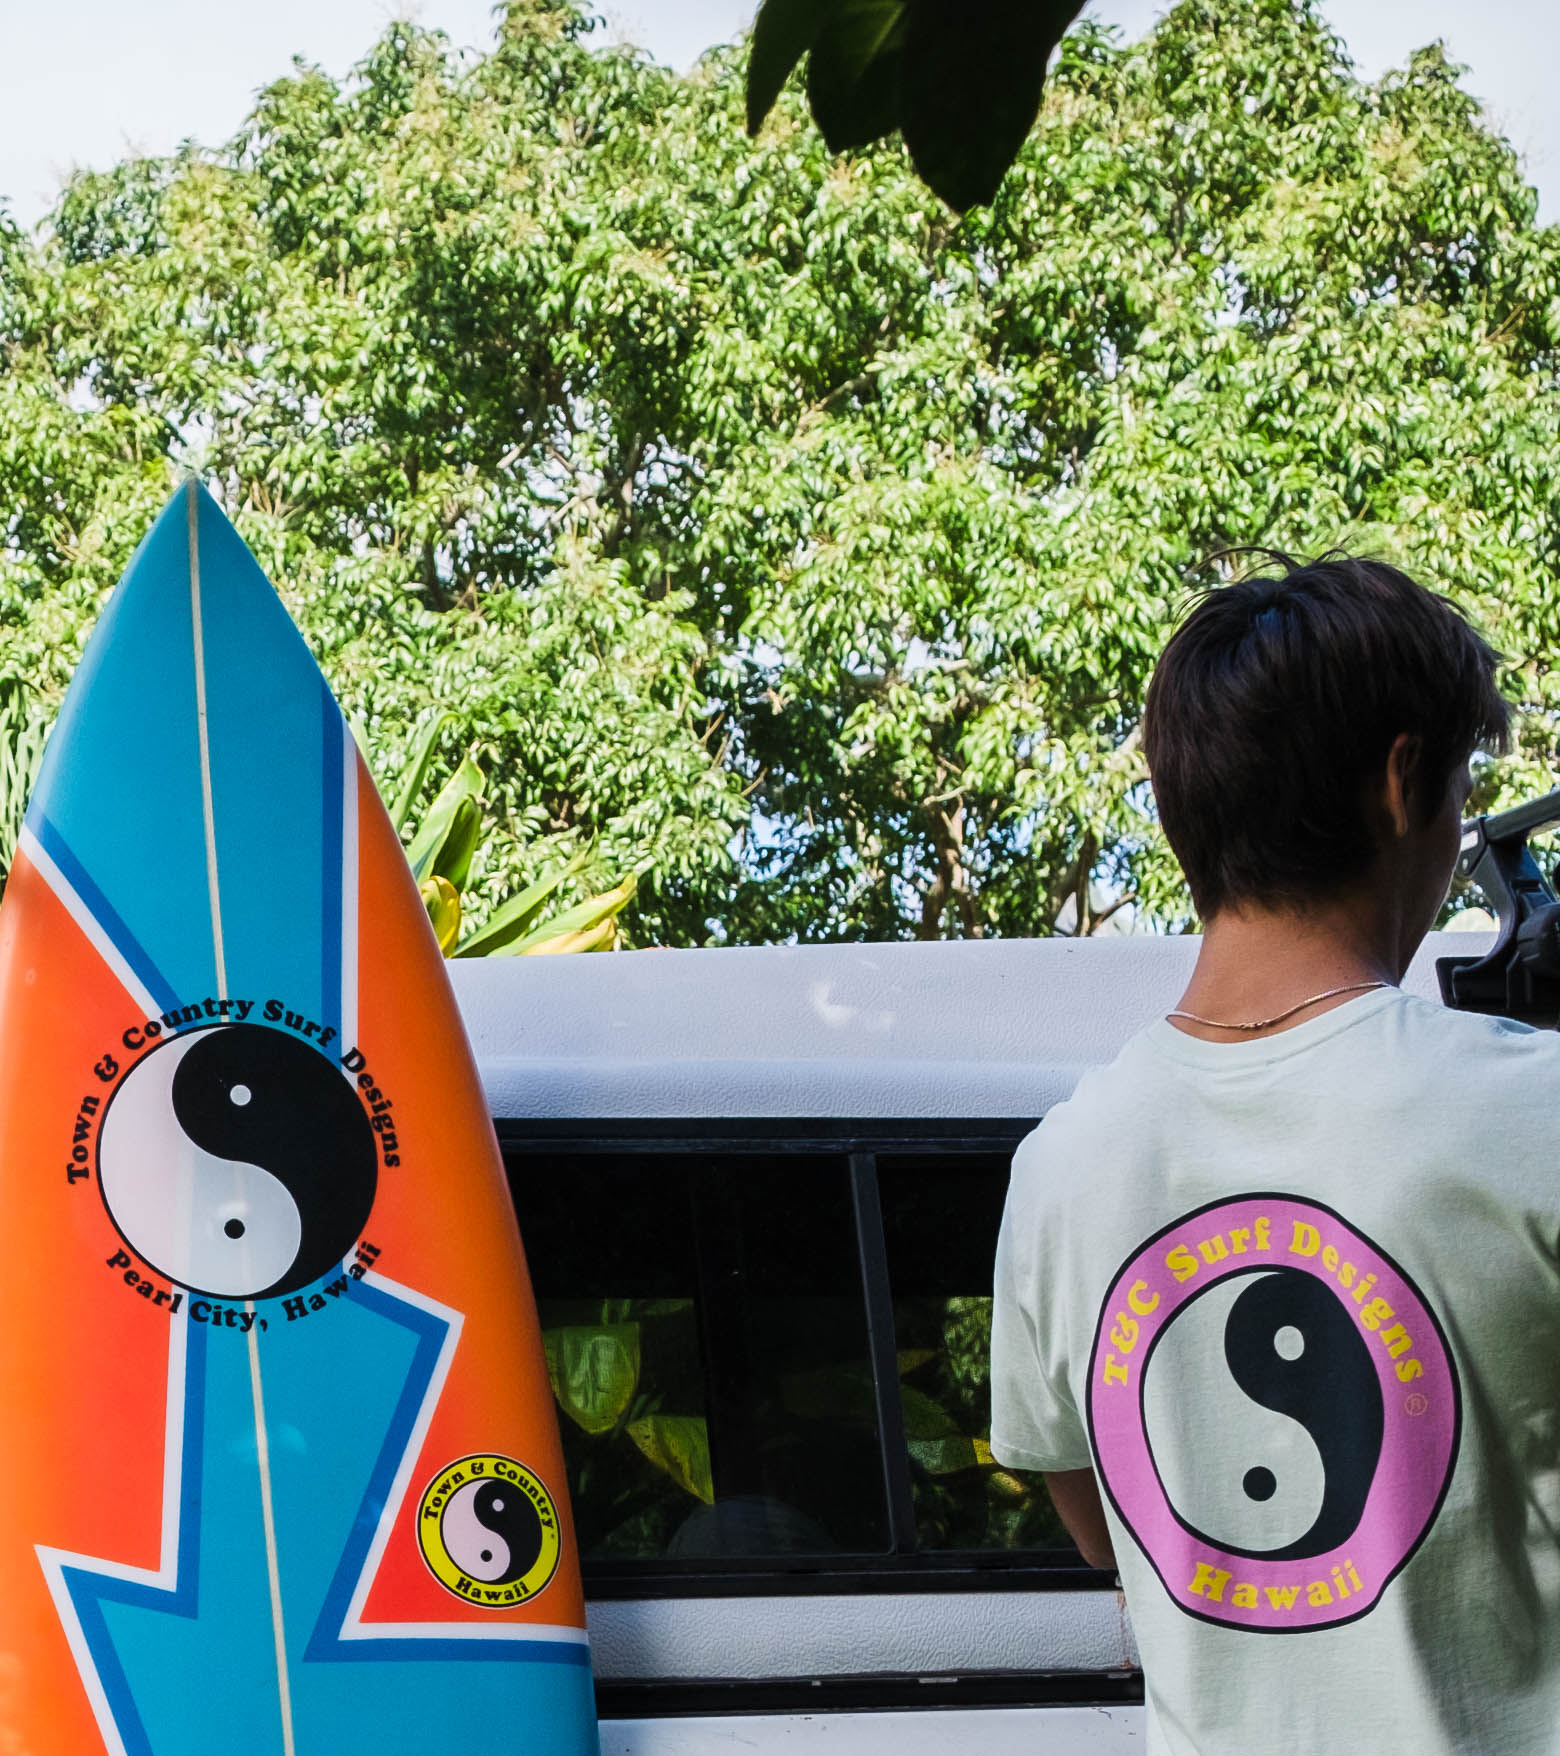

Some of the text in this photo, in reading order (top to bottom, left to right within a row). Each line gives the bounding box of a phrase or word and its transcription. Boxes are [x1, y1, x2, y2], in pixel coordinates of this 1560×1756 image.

[66, 997, 400, 1185] Town & Country Surf Designs
[106, 1240, 382, 1333] Pearl City, Hawaii
[1102, 1216, 1425, 1387] T&C Surf Designs
[424, 1462, 555, 1529] Town & Country
[455, 1576, 531, 1602] Hawaii
[1187, 1560, 1365, 1611] Hawaii
